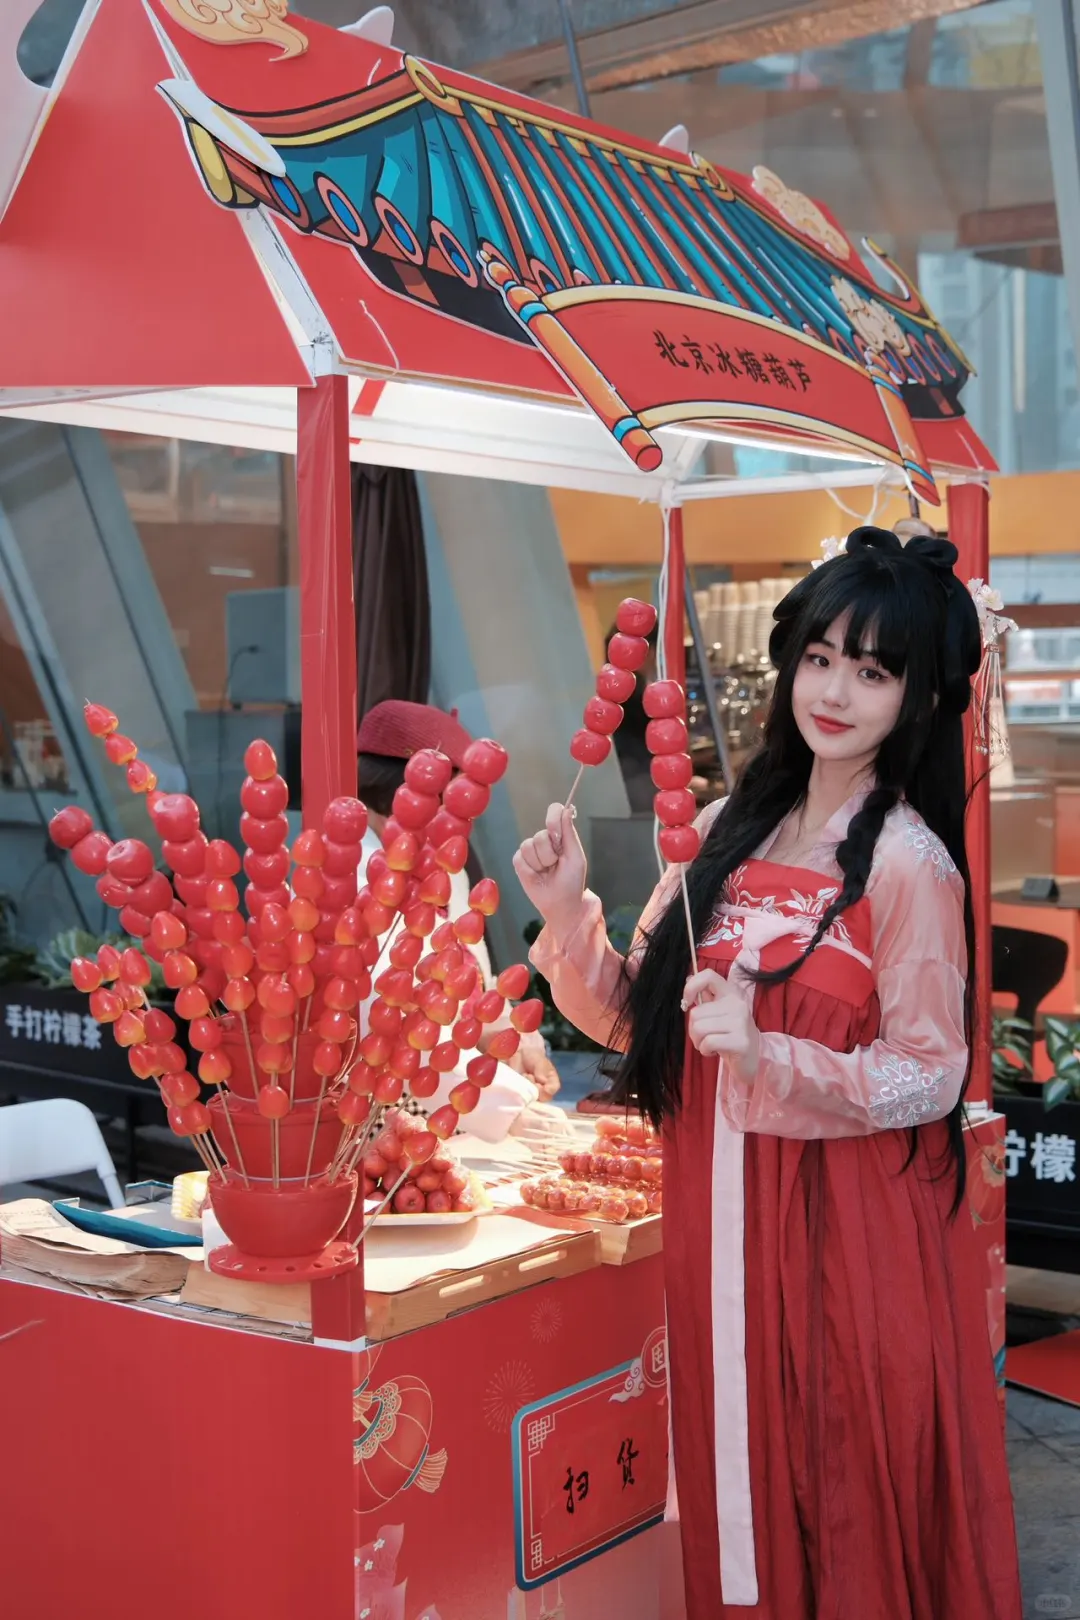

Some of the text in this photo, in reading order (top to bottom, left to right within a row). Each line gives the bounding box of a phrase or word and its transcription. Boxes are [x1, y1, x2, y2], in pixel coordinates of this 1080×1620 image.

[652, 329, 812, 393] 北京冰糖葫芦
[563, 1437, 668, 1514] 扫货
